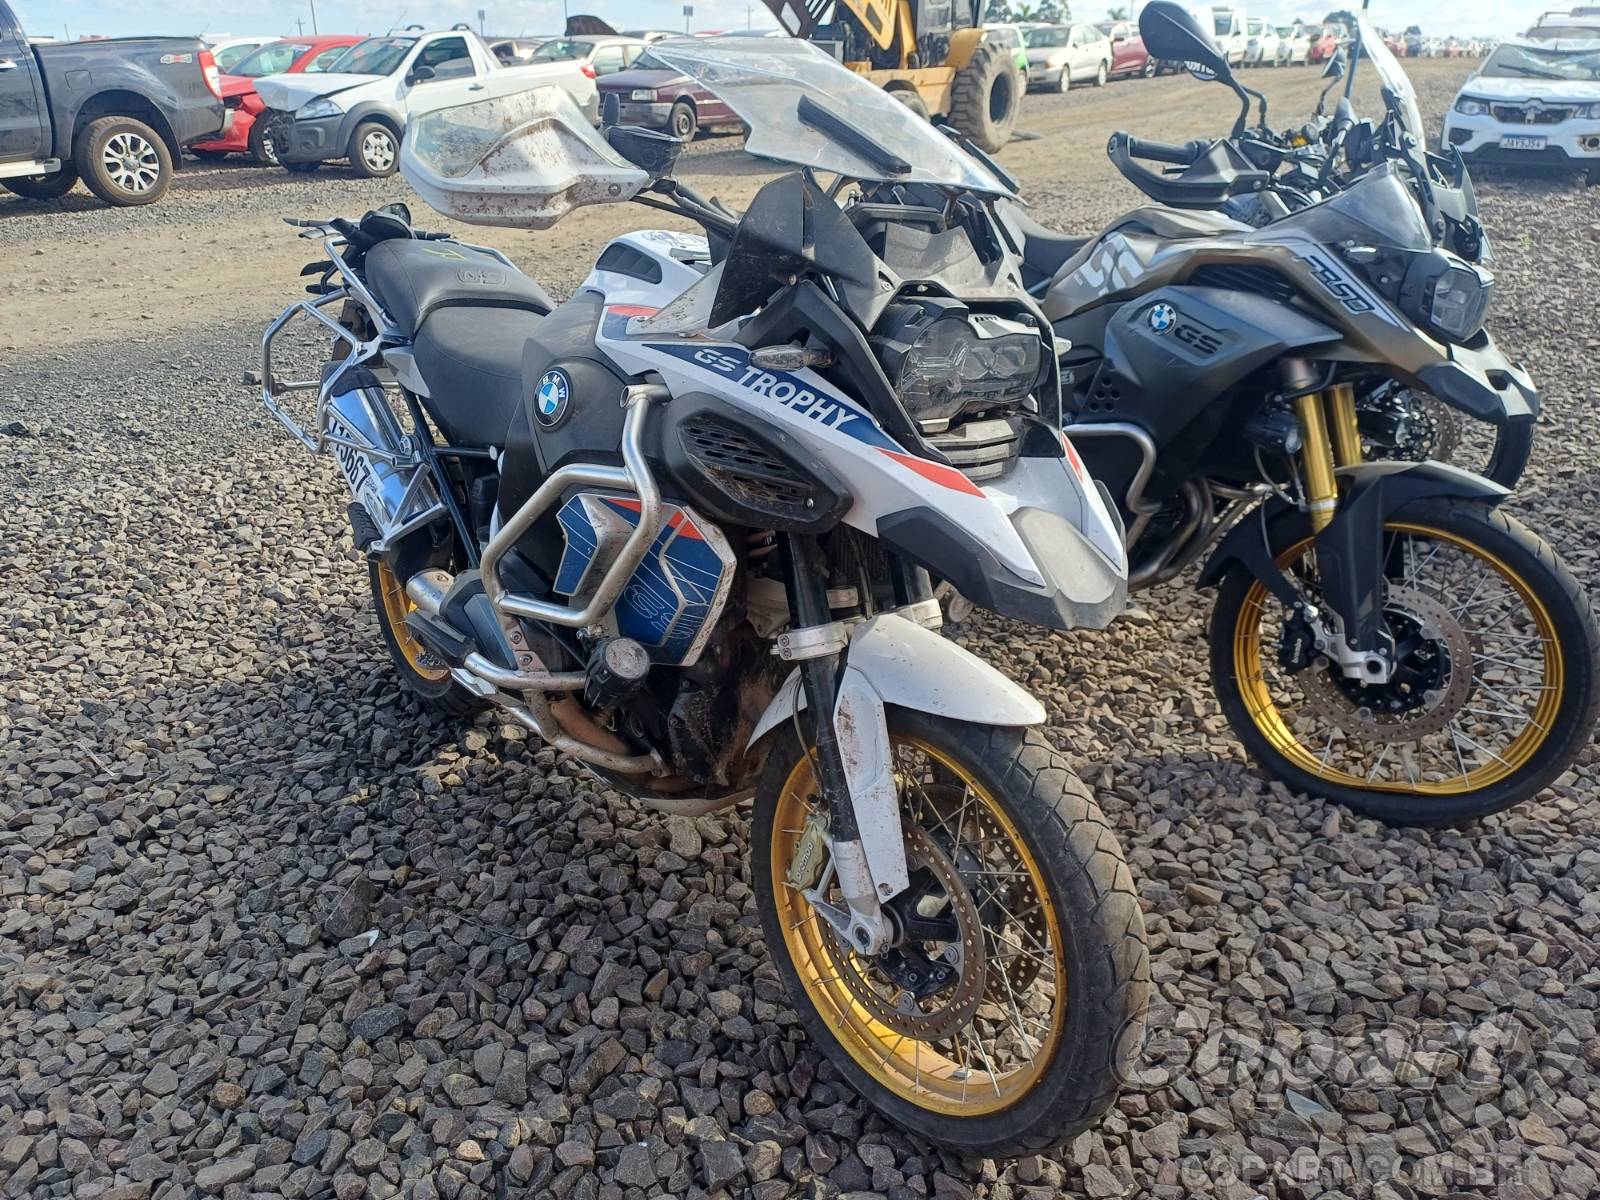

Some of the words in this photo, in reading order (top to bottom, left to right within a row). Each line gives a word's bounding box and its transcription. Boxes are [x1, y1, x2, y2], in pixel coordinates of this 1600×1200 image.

[1174, 323, 1223, 354] GS
[694, 348, 742, 372] GS
[737, 366, 859, 430] TROPHY
